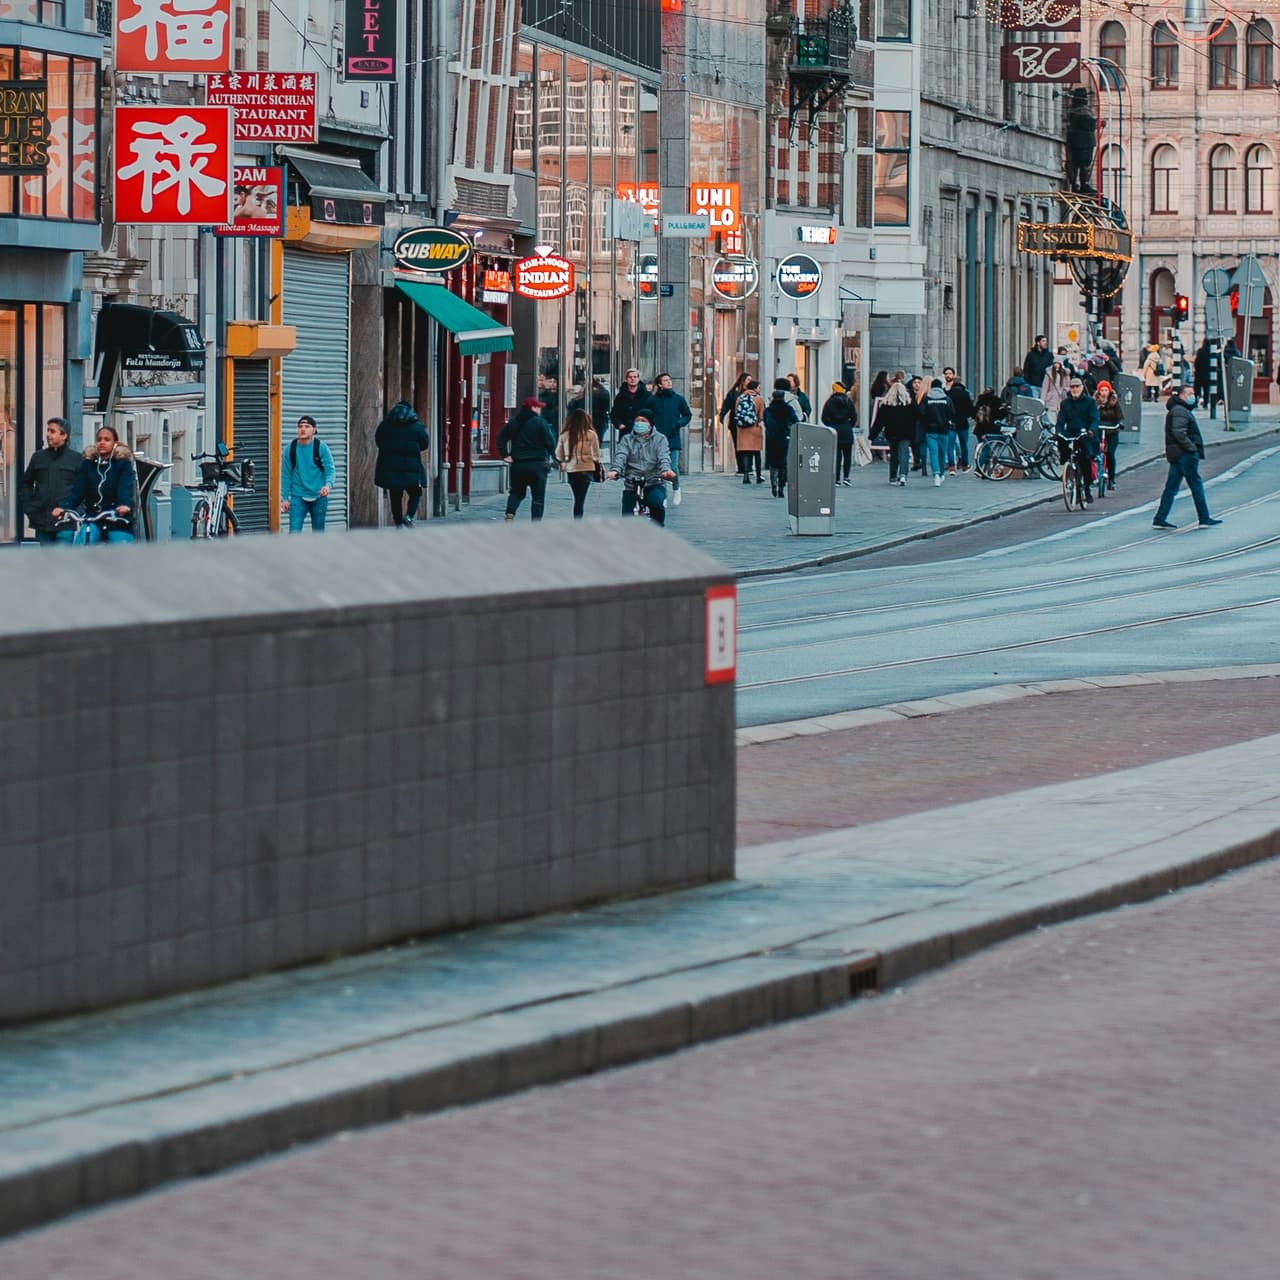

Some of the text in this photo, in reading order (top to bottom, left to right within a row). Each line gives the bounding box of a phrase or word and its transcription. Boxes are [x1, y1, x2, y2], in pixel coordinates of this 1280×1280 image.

[1012, 46, 1078, 79] P&C
[208, 93, 314, 106] AUTHENTIC SICHUAN
[233, 108, 308, 120] STAURANT
[235, 124, 314, 140] NDARIJN
[695, 188, 731, 206] UNI
[247, 223, 280, 234] Massage
[668, 222, 705, 230] PULL&BEAR
[396, 242, 470, 260] SUBWAY
[519, 258, 569, 271] KOH-I-NOOR
[781, 265, 801, 274] THE
[519, 271, 569, 284] INDIAN
[780, 273, 819, 283] BAKERY
